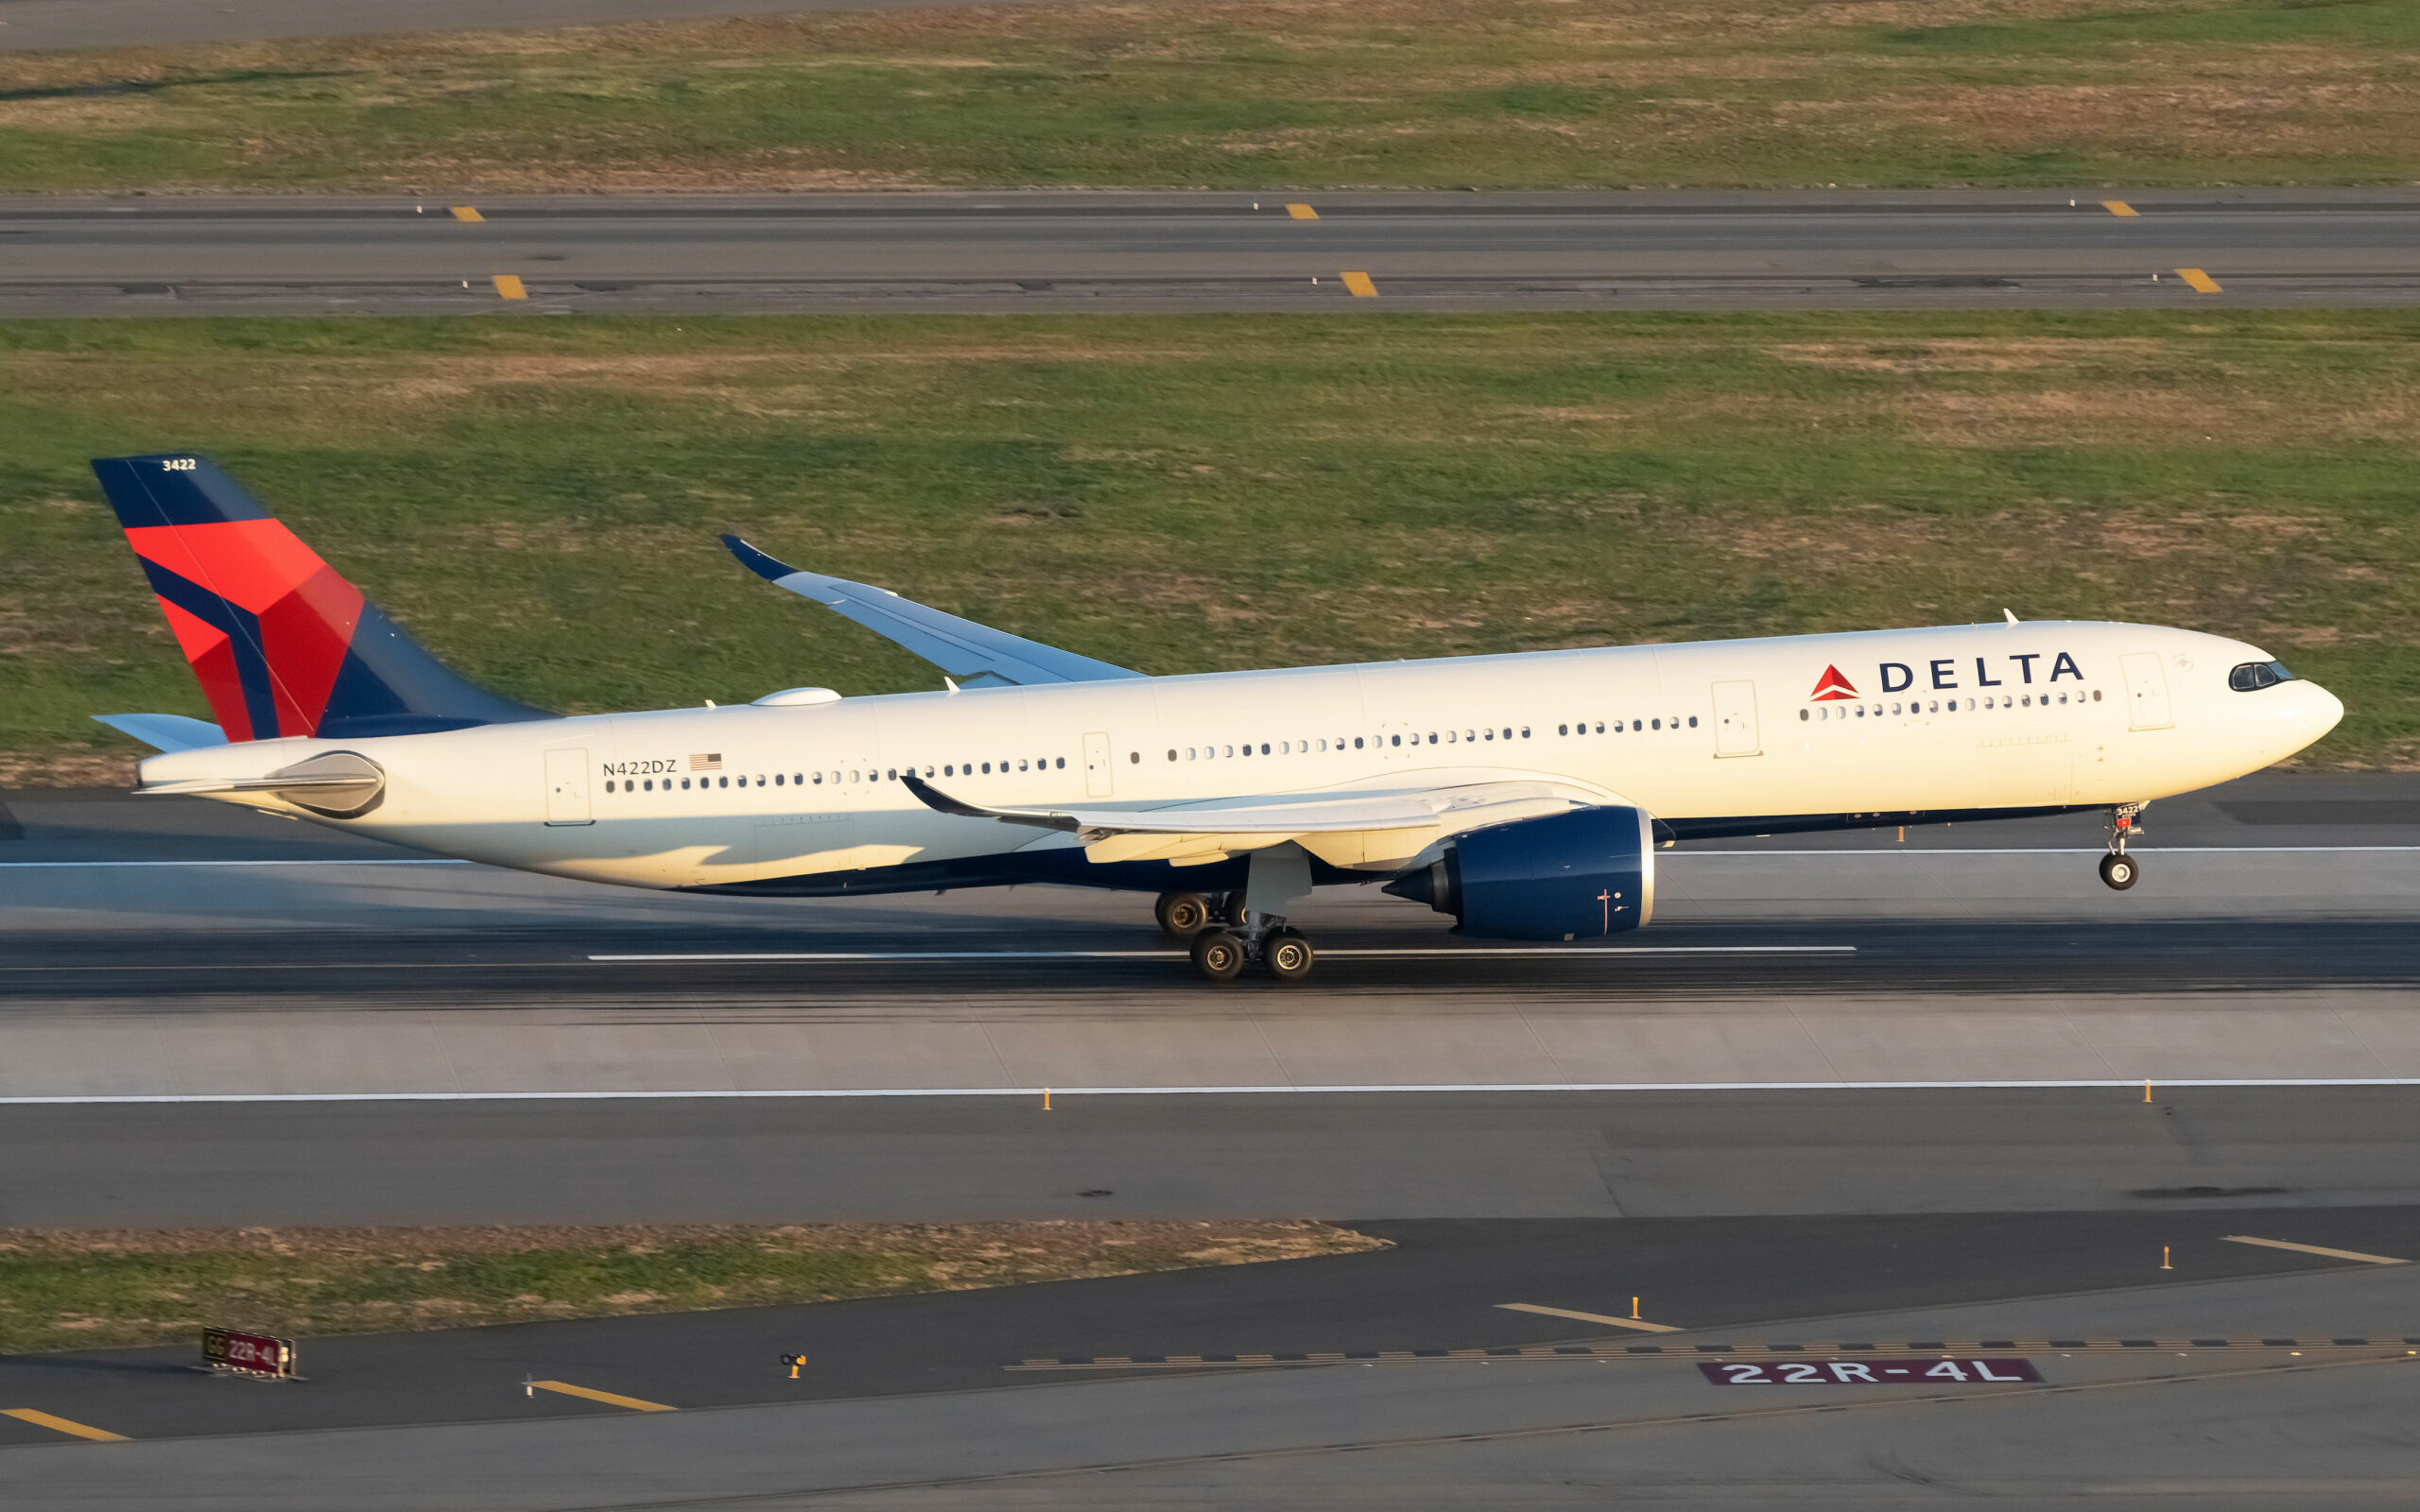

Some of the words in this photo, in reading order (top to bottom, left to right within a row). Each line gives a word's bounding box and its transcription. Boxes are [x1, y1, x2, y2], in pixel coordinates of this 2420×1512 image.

[163, 458, 196, 471] 3422
[1879, 652, 2084, 693] DELTA
[603, 759, 677, 776] N422DZ
[2118, 805, 2138, 816] 3422
[229, 1339, 277, 1366] 22R-4L
[1720, 1361, 2023, 1383] 22R-4L
